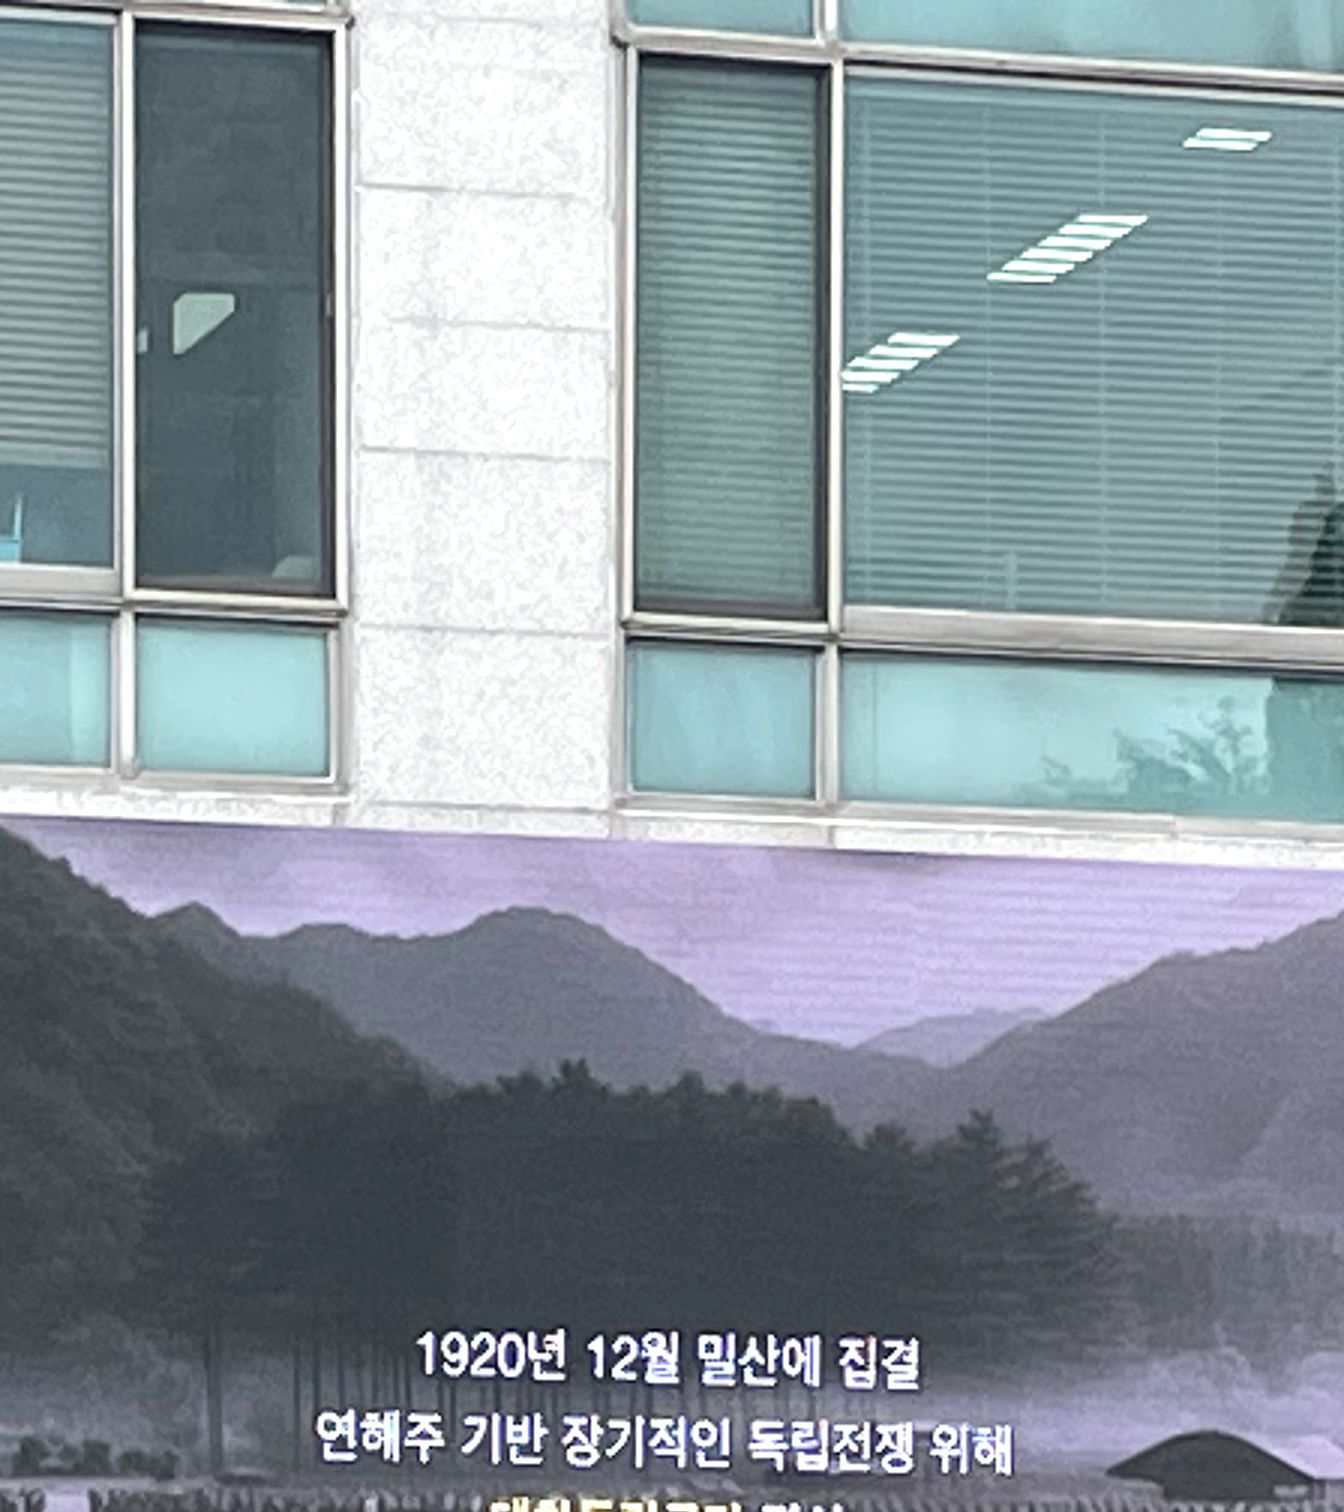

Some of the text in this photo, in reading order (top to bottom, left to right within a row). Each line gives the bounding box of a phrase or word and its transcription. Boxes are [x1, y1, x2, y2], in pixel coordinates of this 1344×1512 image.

[416, 1328, 920, 1390] 1920년 12월 밀산에 집결
[316, 1408, 1013, 1476] 연해주 기반 장기적인 독립전쟁 위해
